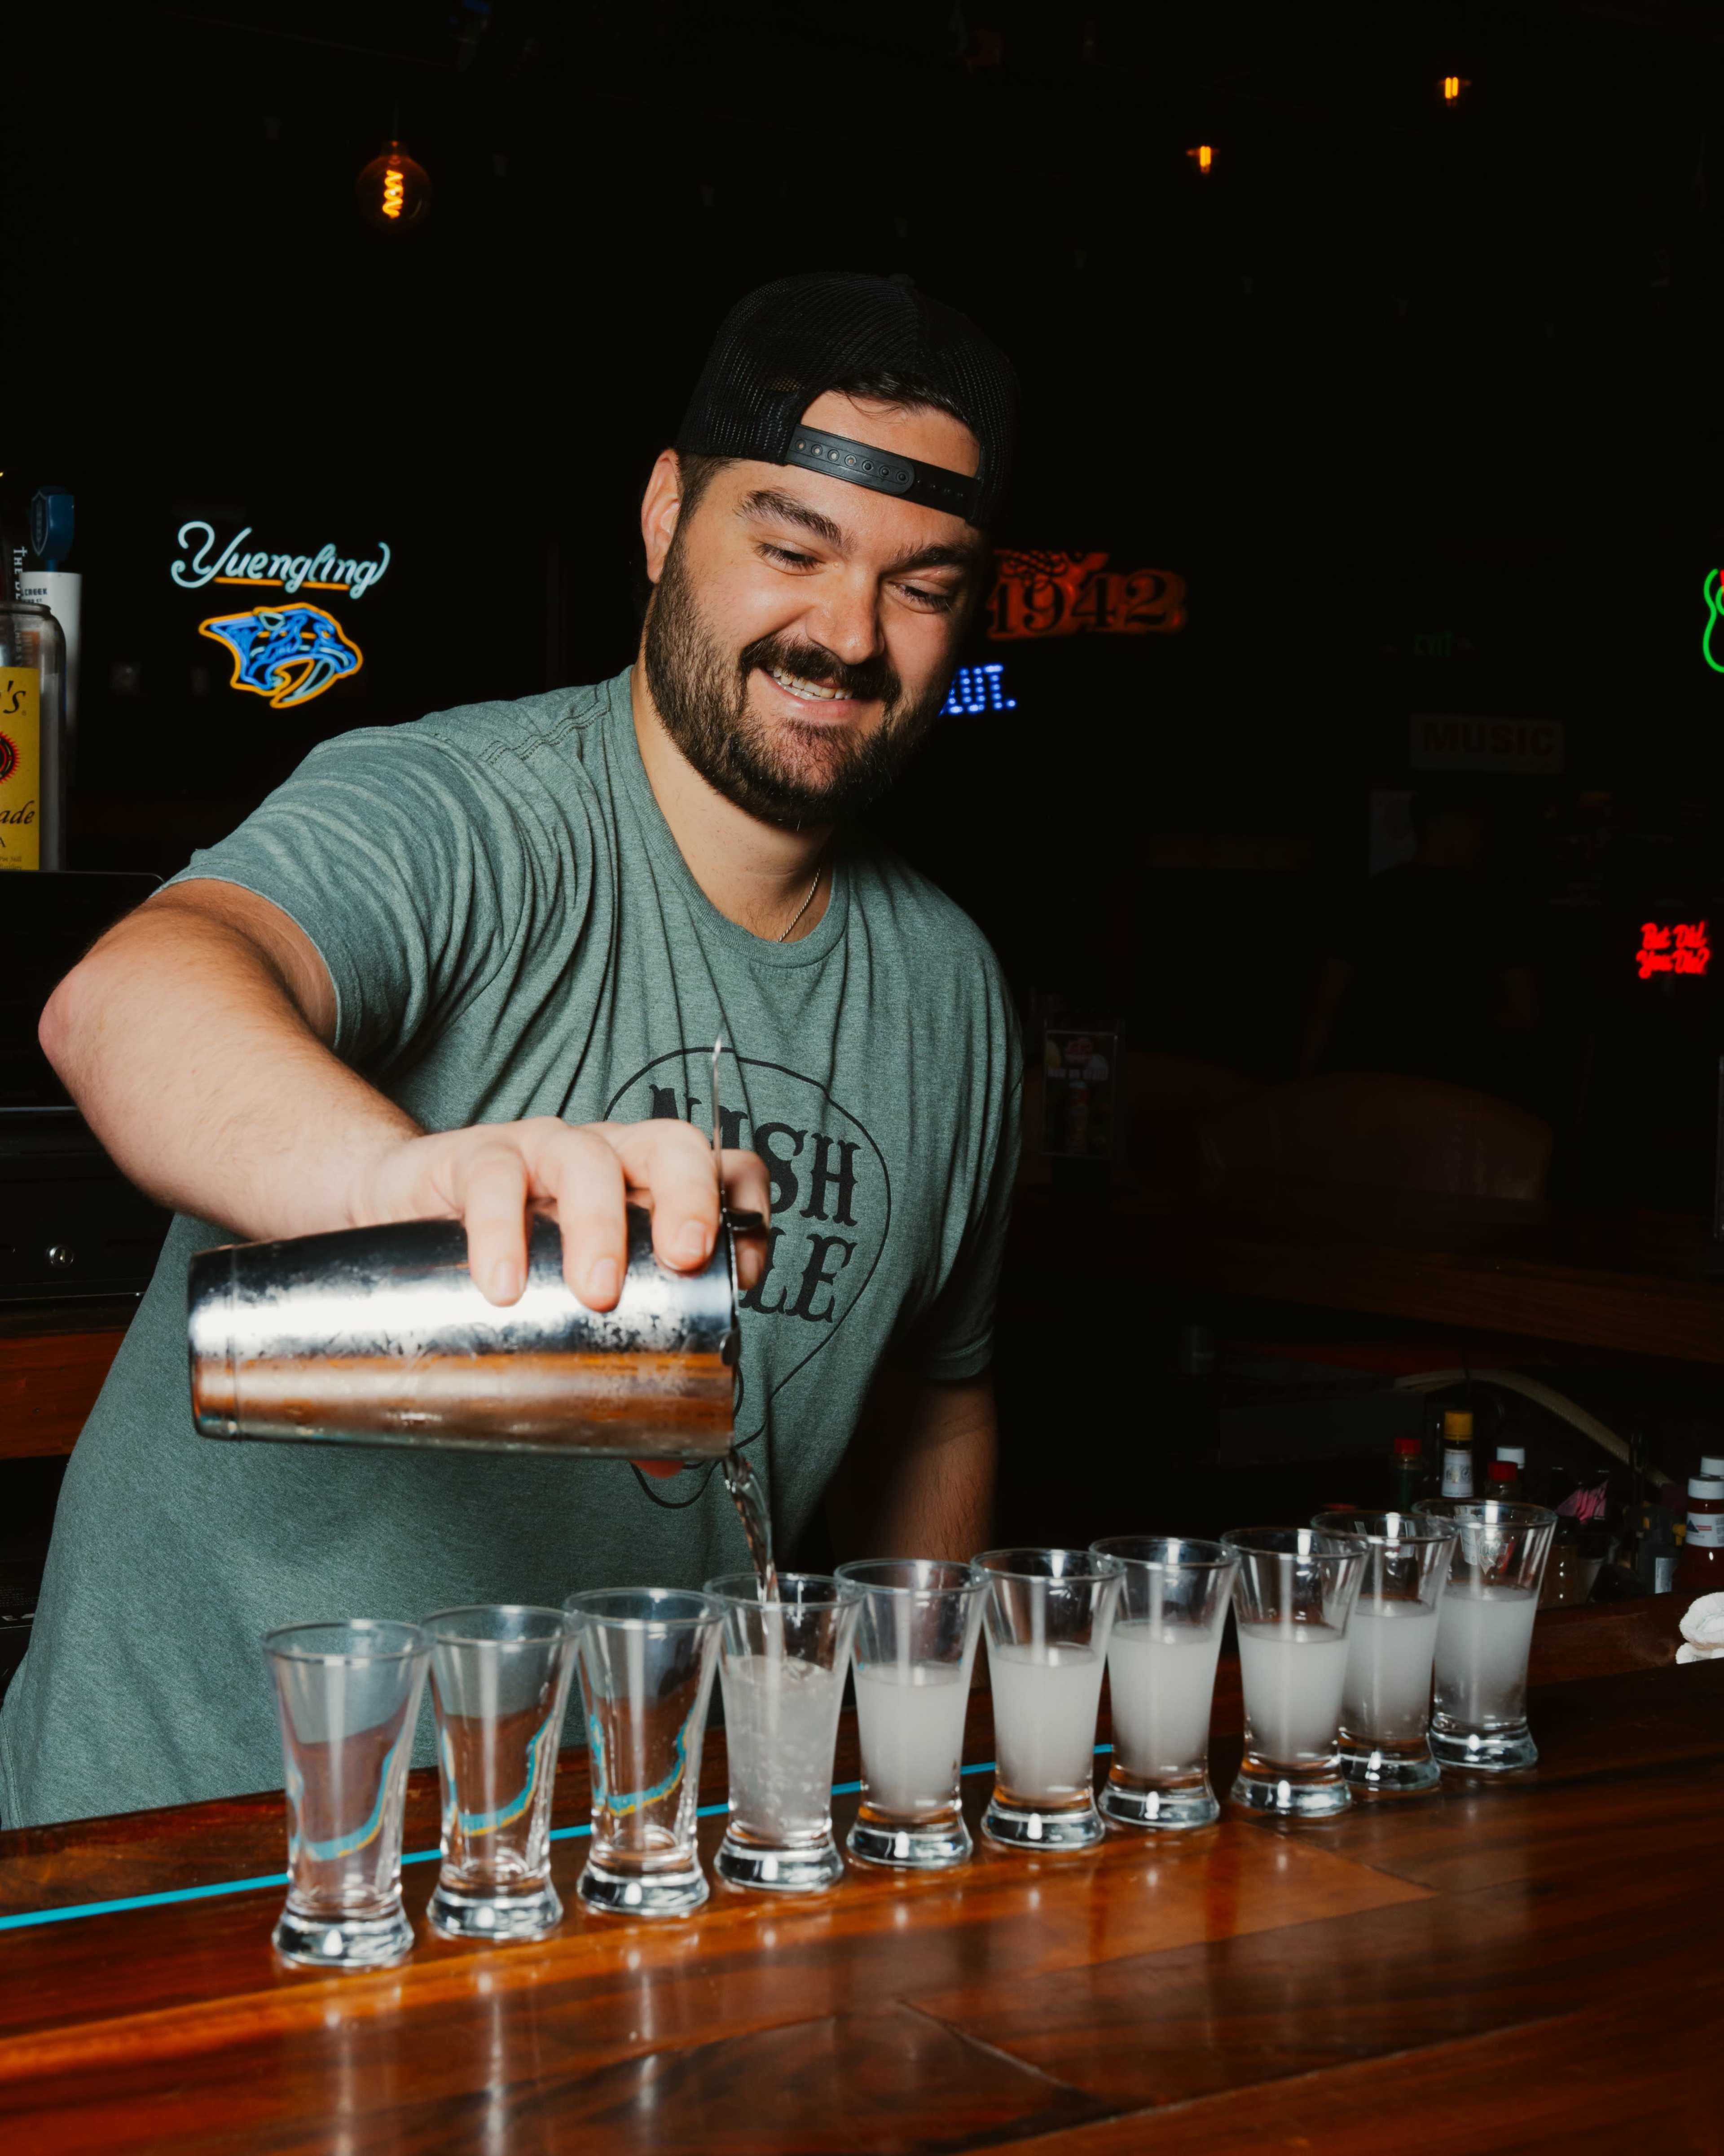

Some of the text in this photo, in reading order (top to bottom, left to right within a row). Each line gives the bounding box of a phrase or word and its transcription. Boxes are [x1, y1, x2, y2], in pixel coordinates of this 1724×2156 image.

[171, 521, 391, 600] Yuengling
[989, 571, 1172, 636] 1942
[1423, 723, 1554, 756] MUSIC
